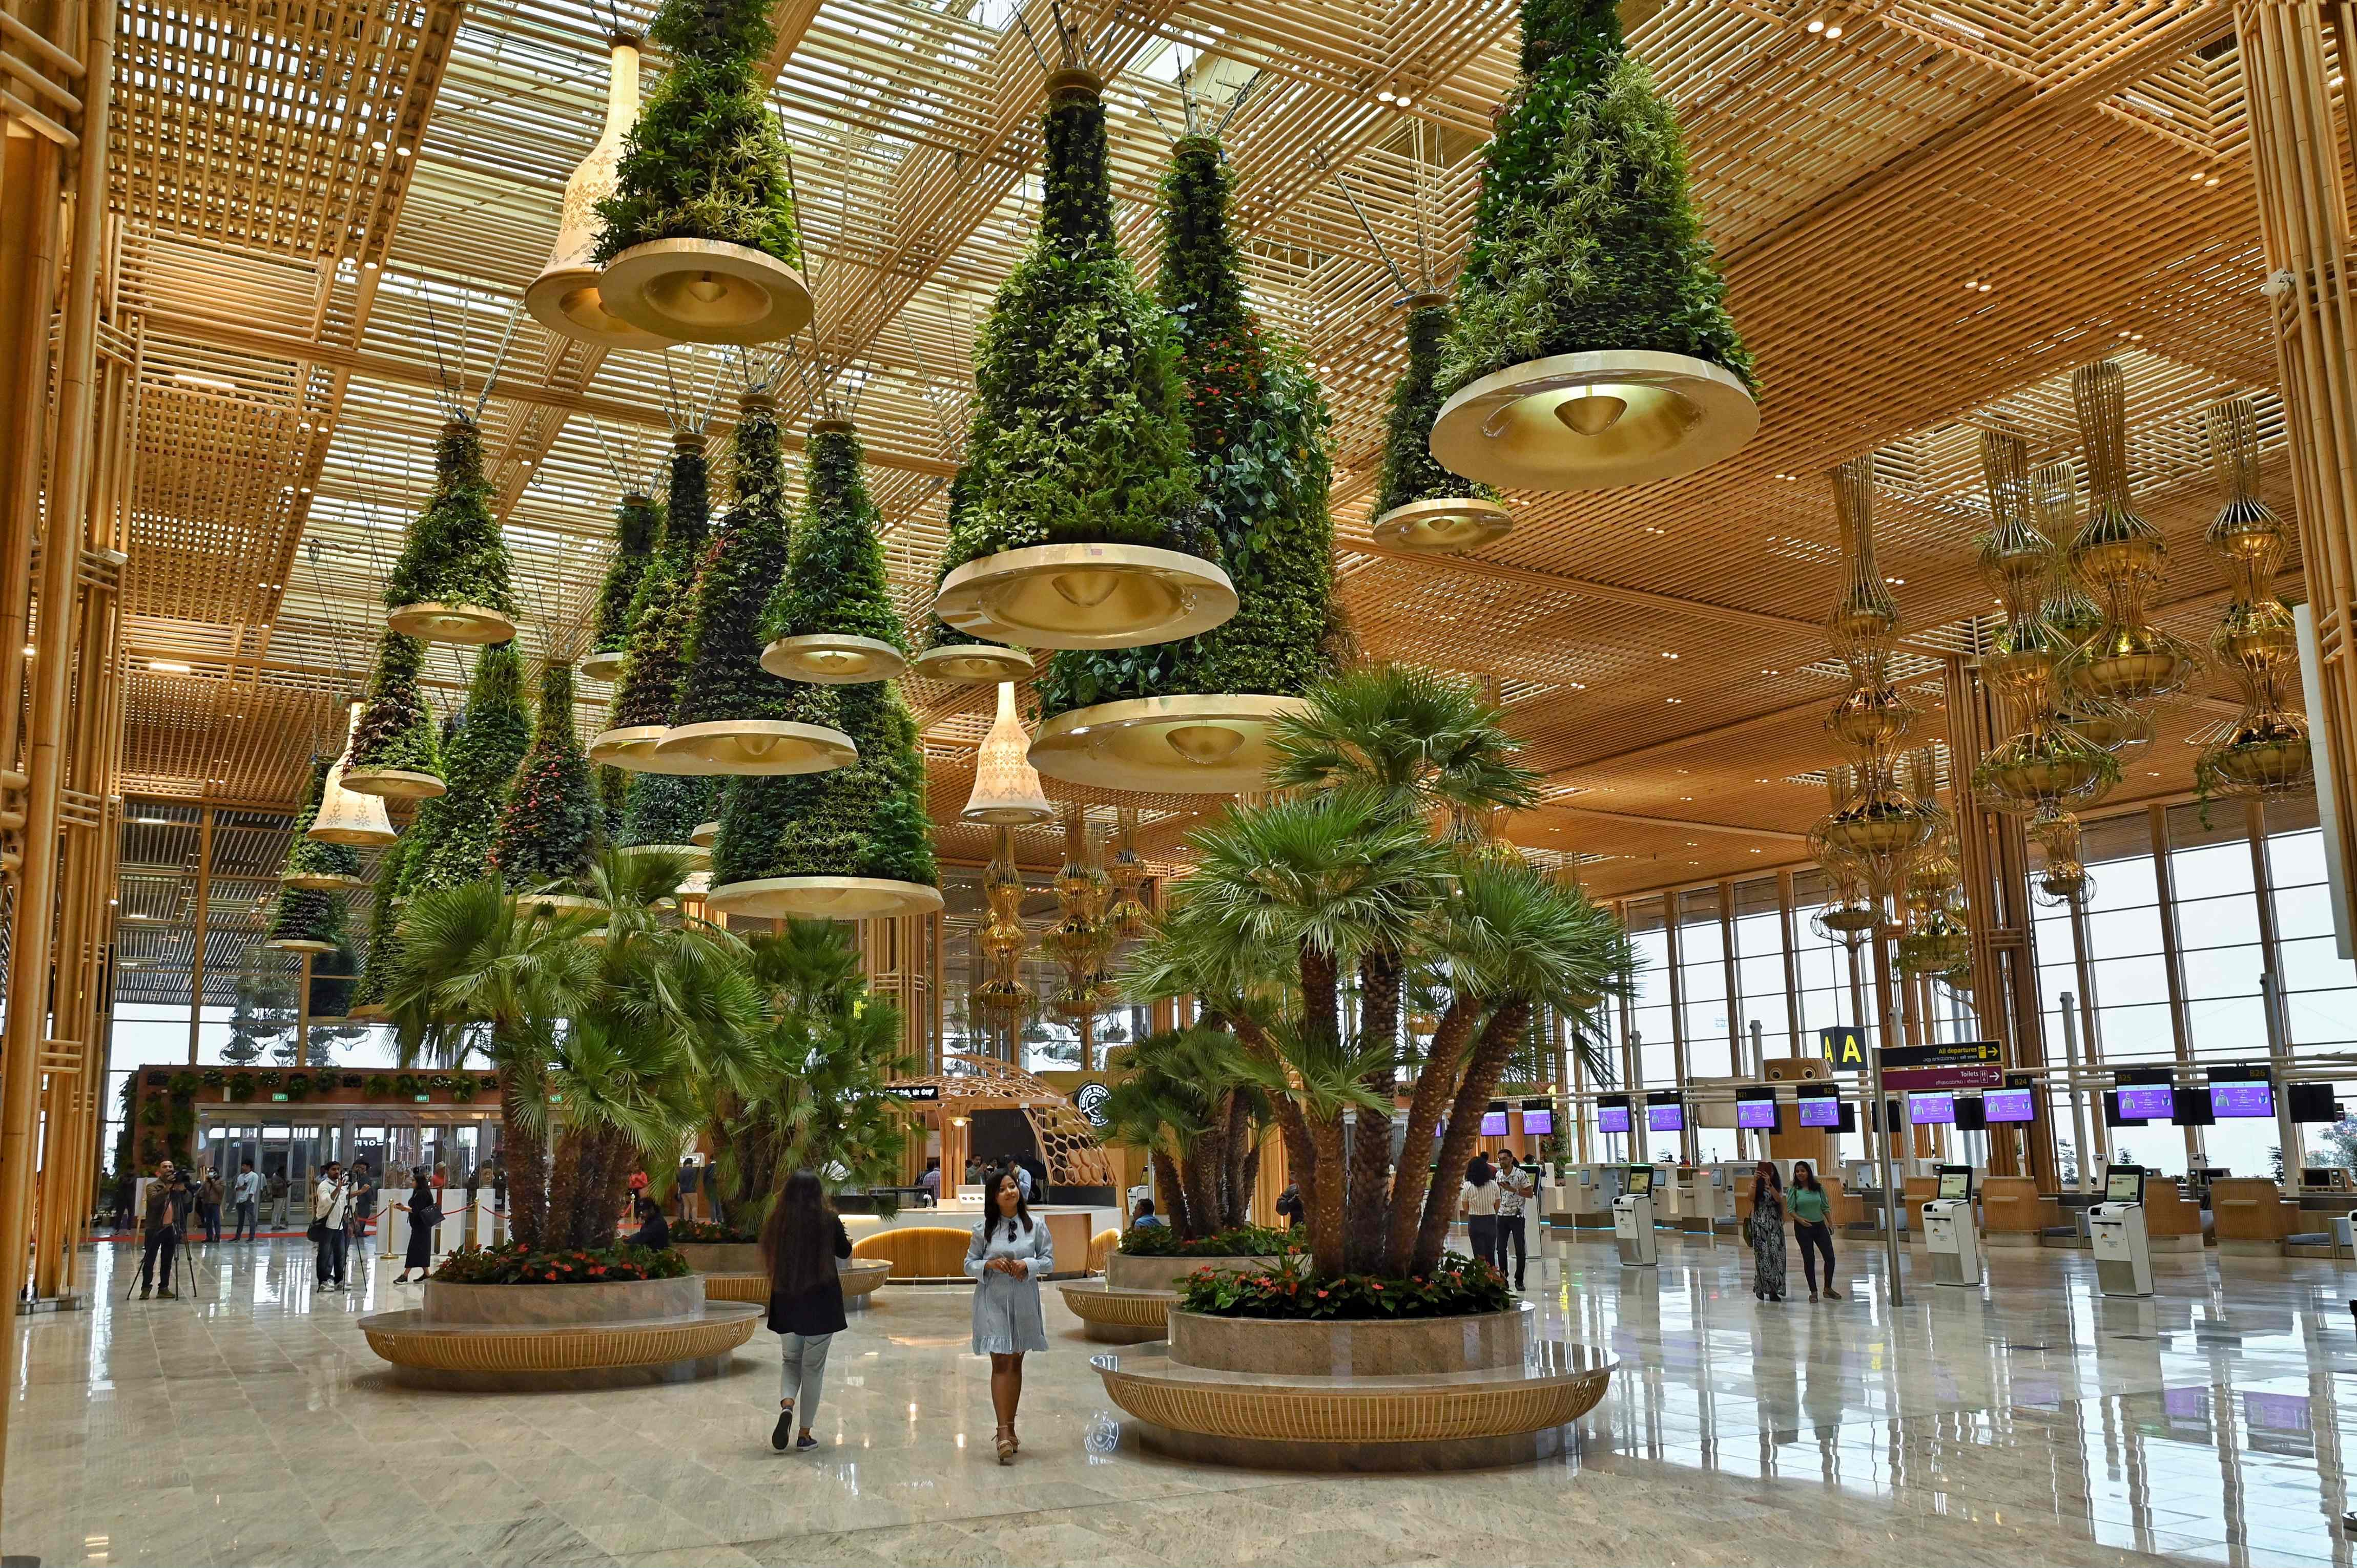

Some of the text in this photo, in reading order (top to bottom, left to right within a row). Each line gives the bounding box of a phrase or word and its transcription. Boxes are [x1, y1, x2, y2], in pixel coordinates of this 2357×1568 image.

[1825, 1036, 1833, 1063] A
[1842, 1035, 1862, 1062] A
[2117, 1074, 2132, 1082] B25
[2249, 1069, 2265, 1078] B26
[1081, 1089, 1093, 1108] COFFEE
